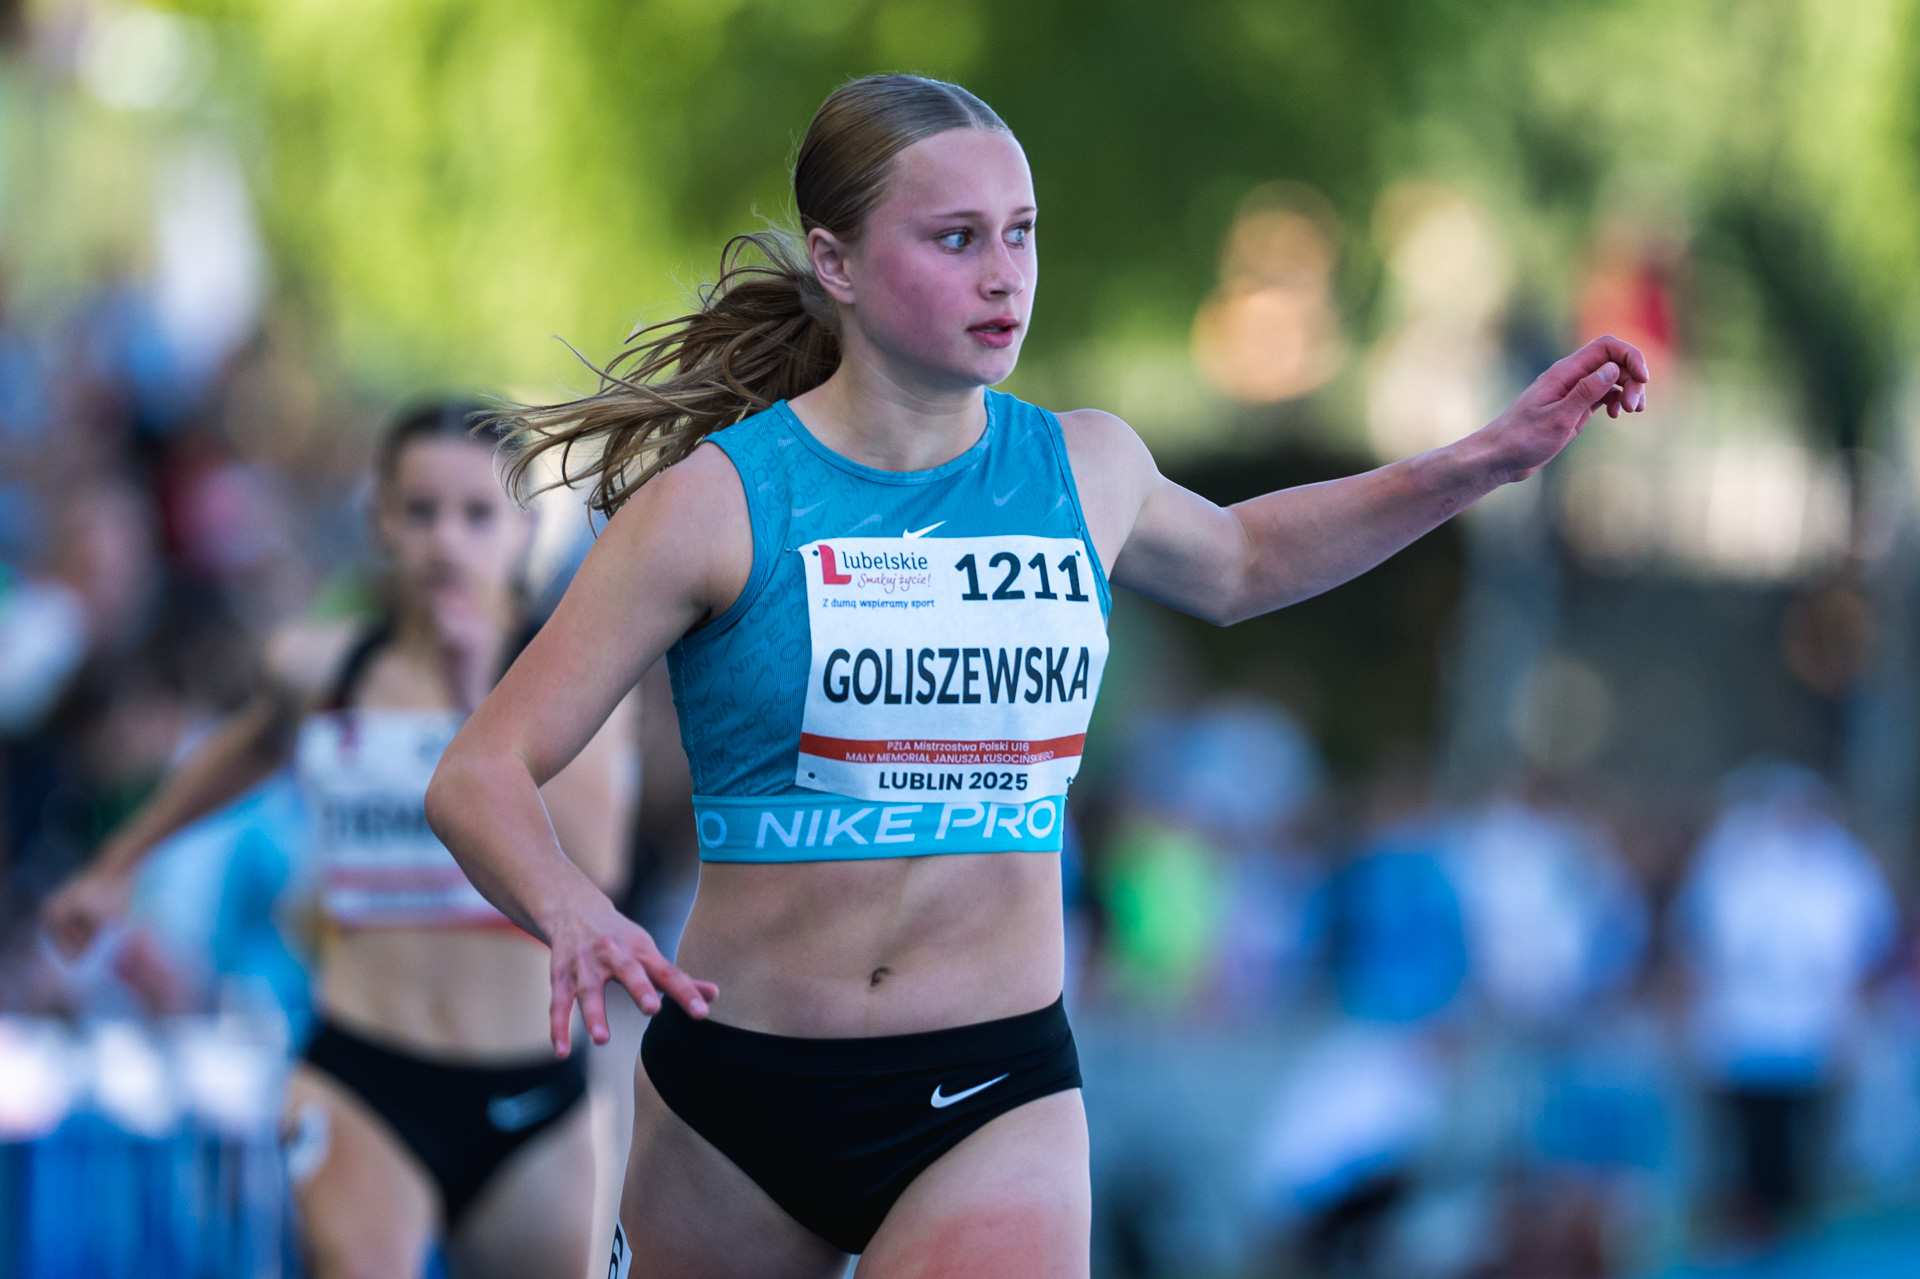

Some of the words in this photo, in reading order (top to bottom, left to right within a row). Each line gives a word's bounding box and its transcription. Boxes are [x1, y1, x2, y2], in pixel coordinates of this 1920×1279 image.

[842, 551, 928, 570] lubelskie
[857, 573, 897, 594] Smakuj
[954, 551, 1089, 602] 1211
[822, 598, 829, 608] Z
[831, 598, 857, 609] dumą
[859, 599, 909, 610] wspieramy
[911, 599, 935, 609] sport
[823, 646, 1090, 705] GOLISZEWSKA
[886, 741, 912, 751] PZLA
[913, 741, 977, 752] Mistrzostwa
[979, 741, 1009, 752] Polski
[1011, 741, 1029, 752] U16
[845, 752, 874, 763] MAŁY
[876, 752, 931, 763] MEMORIAŁ
[932, 753, 980, 764] JANUSZA
[982, 750, 1054, 764] KUSOCIŃSKIEGO
[878, 771, 963, 791] LUBLIN
[968, 772, 1028, 791] 2025
[755, 804, 923, 849] NIKE
[934, 799, 1056, 840] PRO
